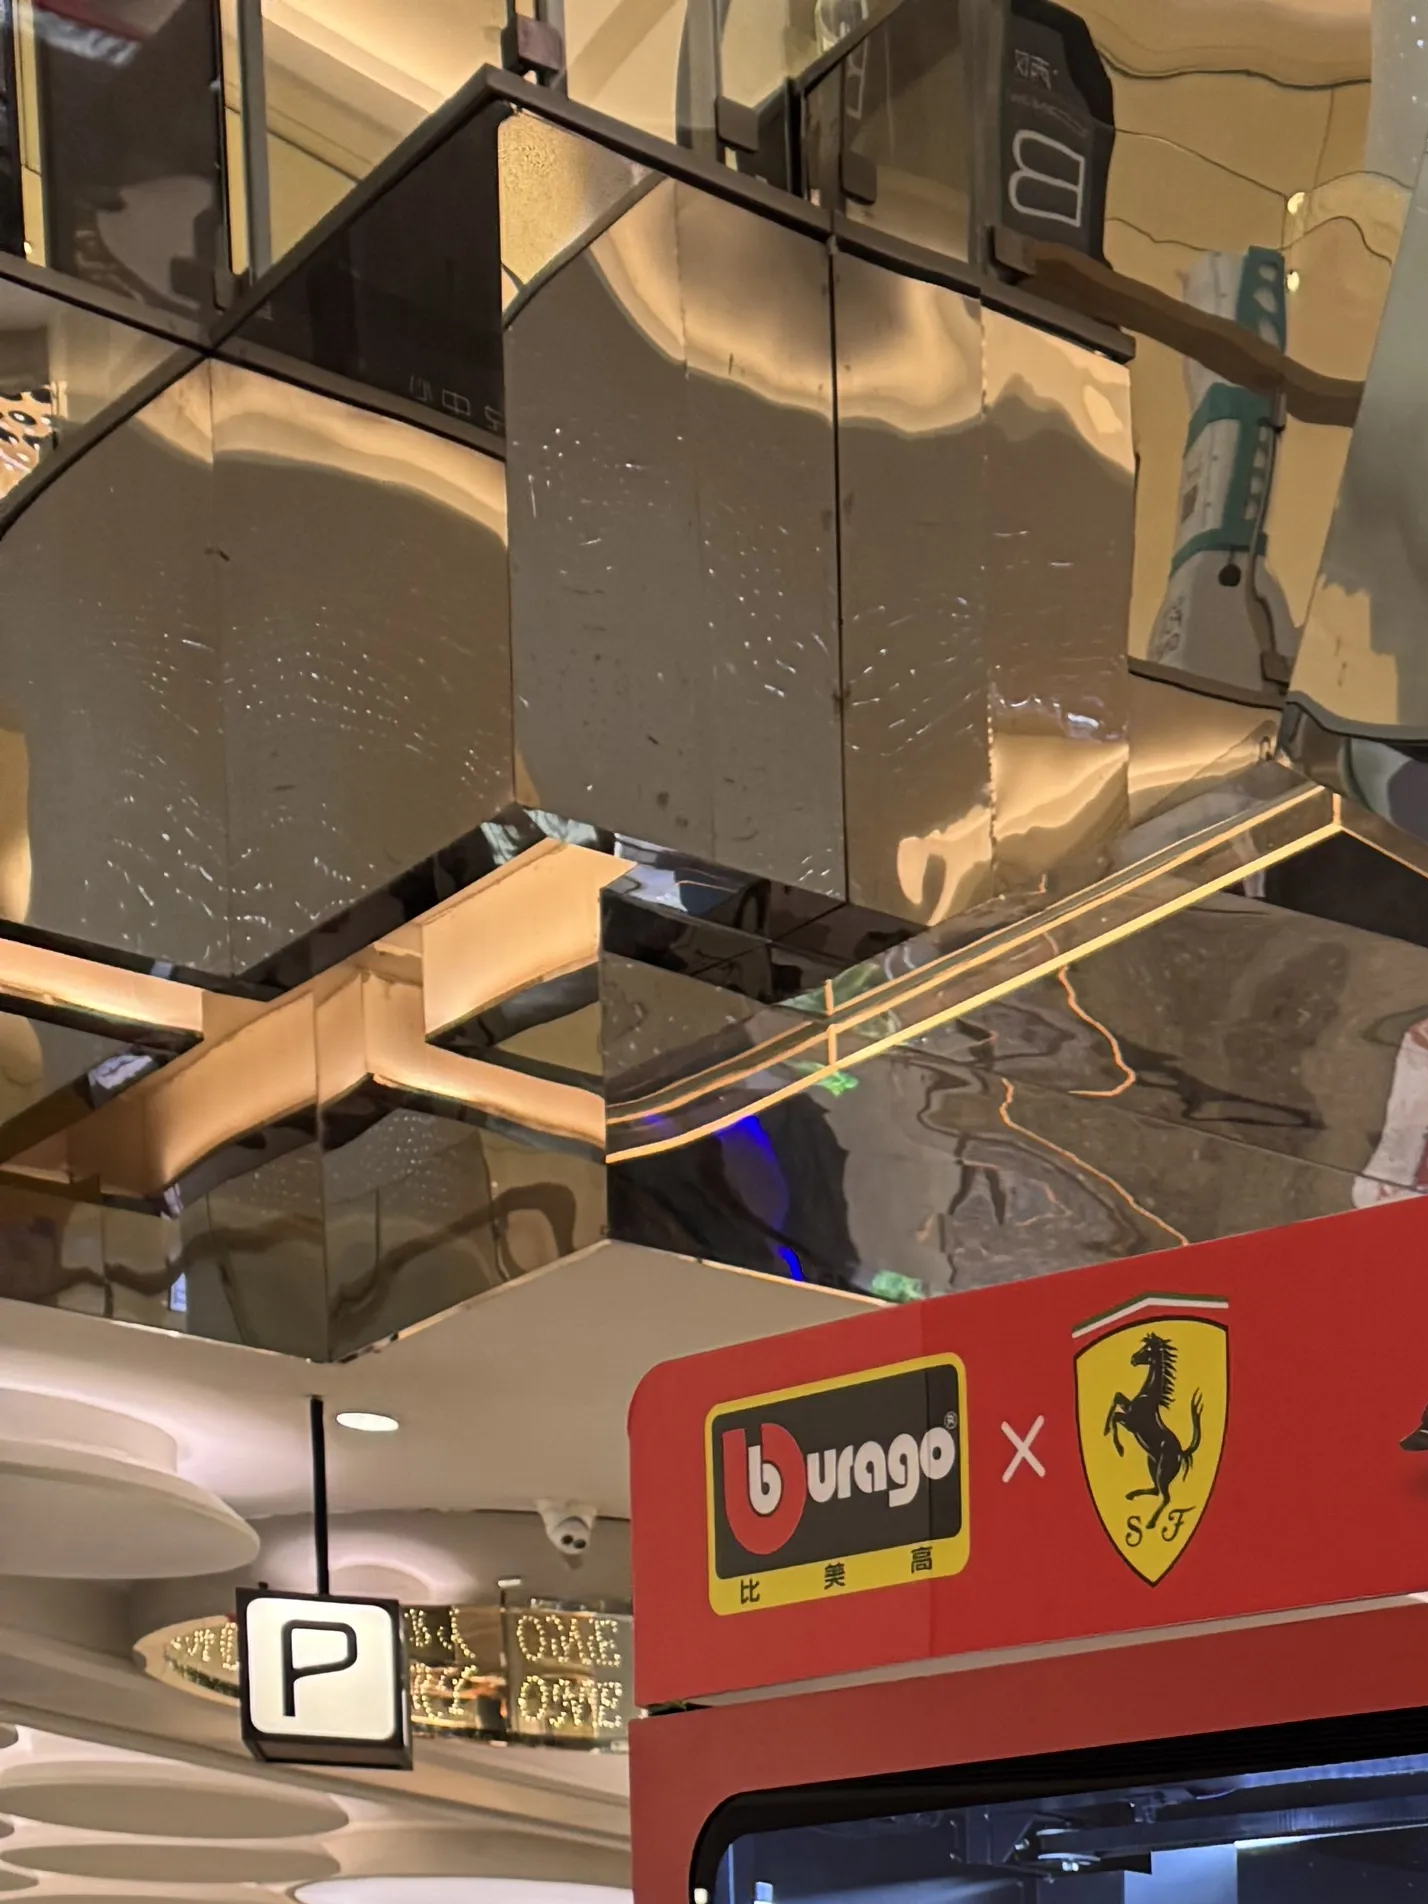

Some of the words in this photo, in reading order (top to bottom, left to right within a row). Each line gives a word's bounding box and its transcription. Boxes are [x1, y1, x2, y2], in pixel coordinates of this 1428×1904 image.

[737, 1545, 935, 1607] 比美高
[281, 1618, 357, 1718] P
